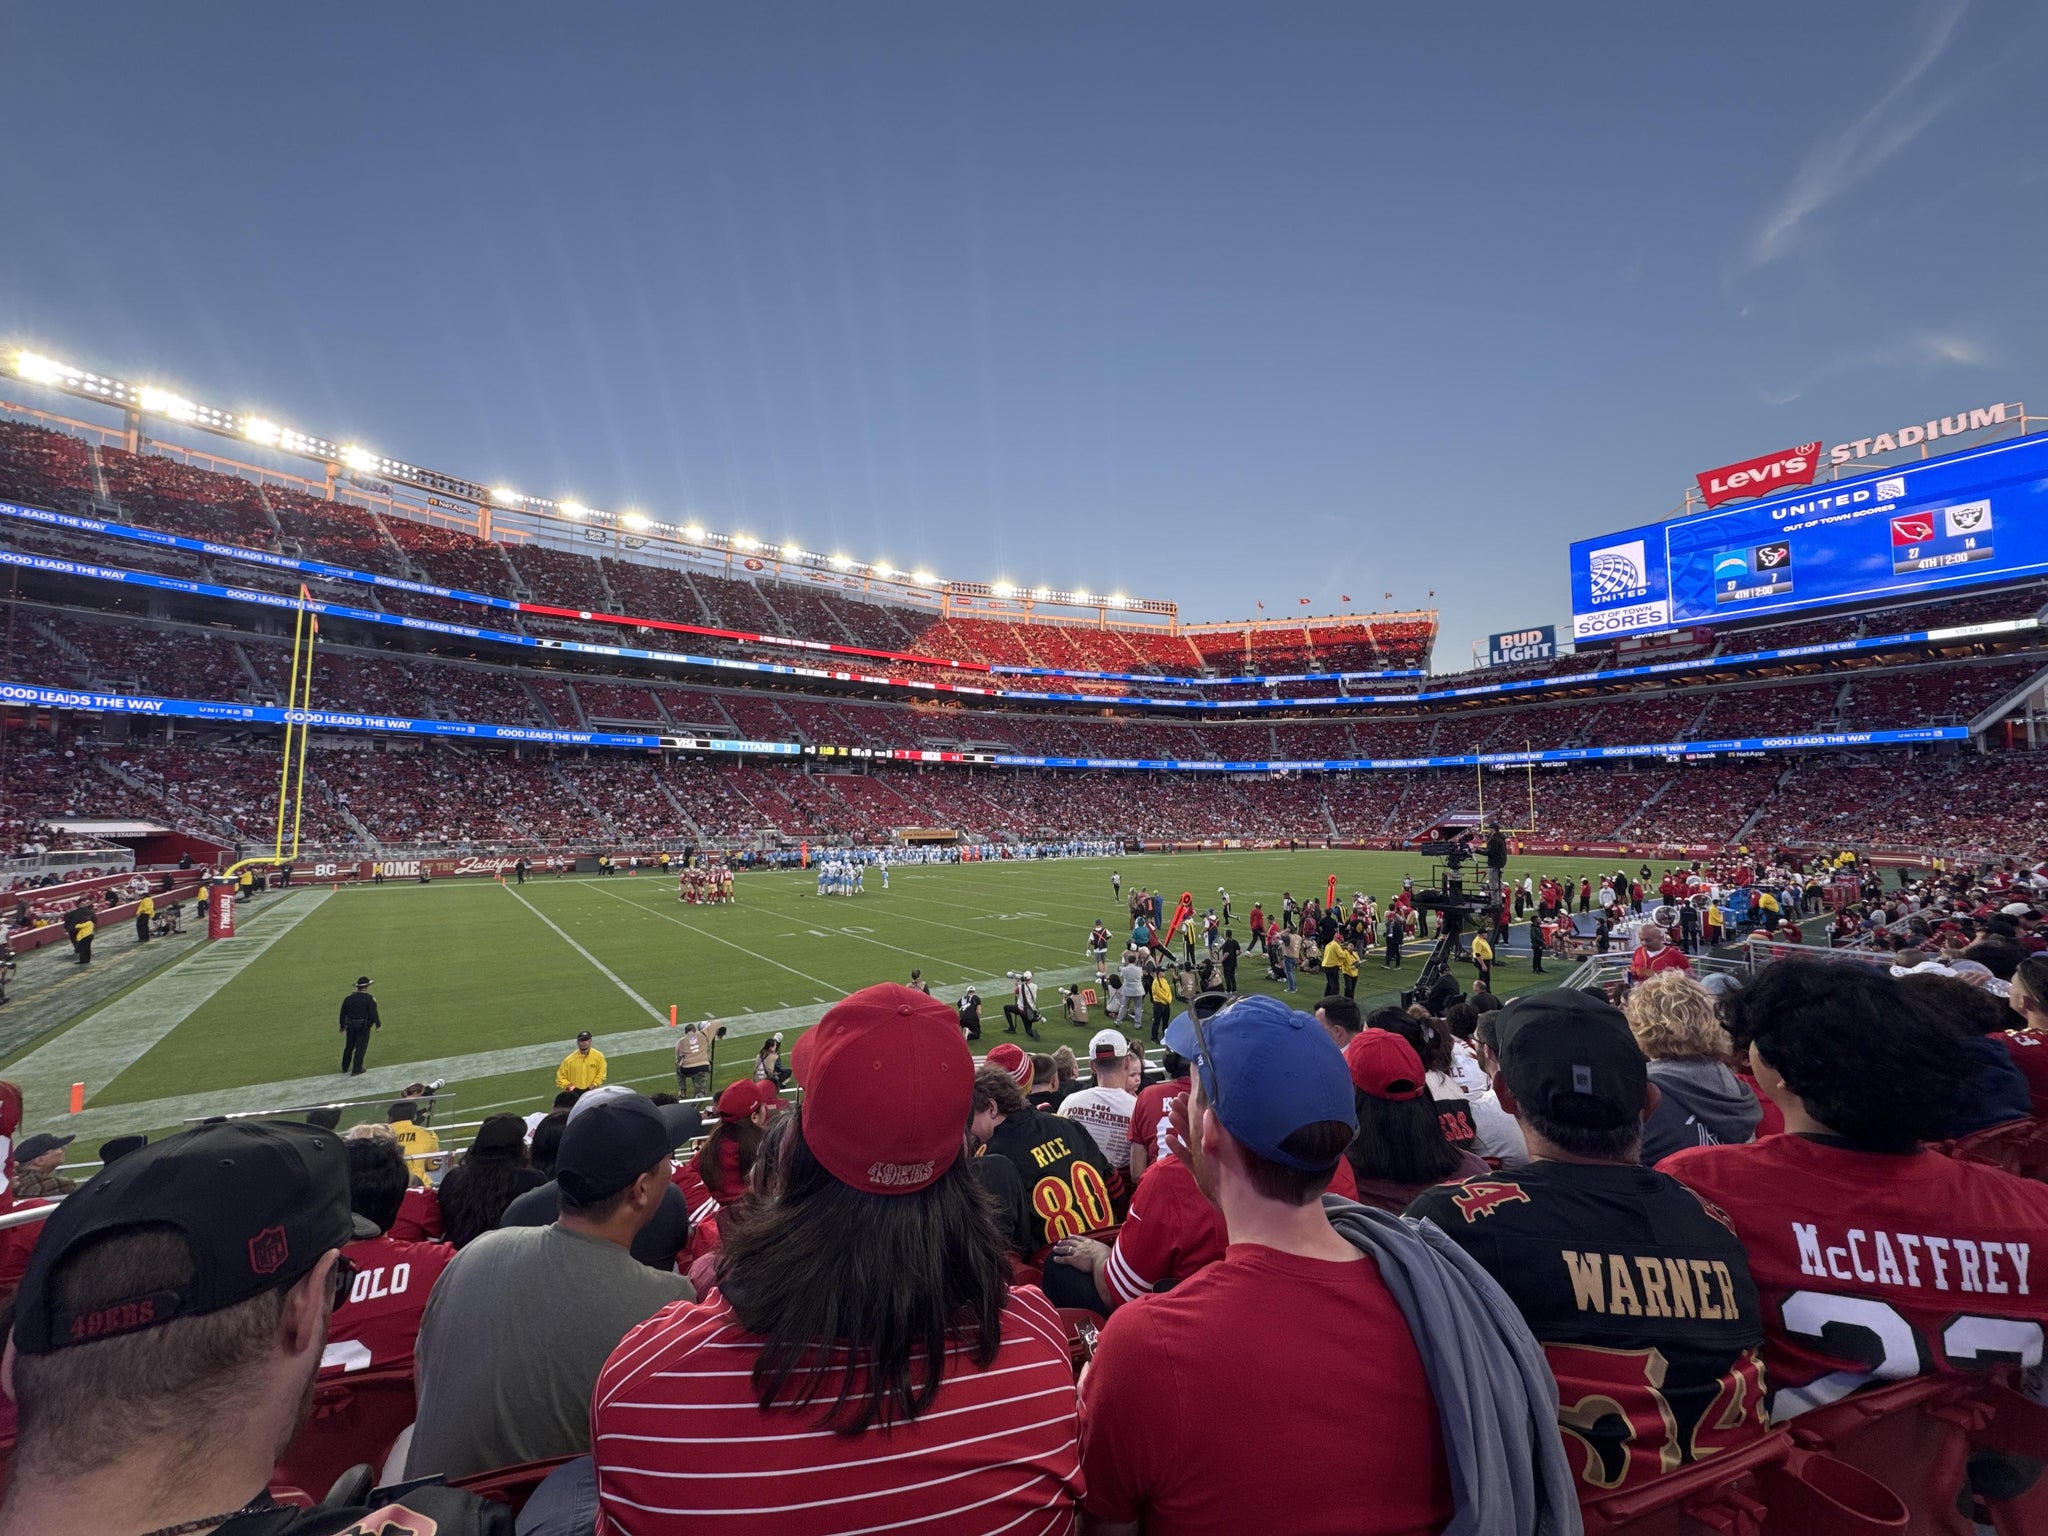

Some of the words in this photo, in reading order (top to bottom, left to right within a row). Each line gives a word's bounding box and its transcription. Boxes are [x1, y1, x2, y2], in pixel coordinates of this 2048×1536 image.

[1830, 402, 2006, 464] STADIUM
[439, 501, 470, 514] NetApp
[1772, 490, 1870, 520] UNITED
[0, 504, 16, 514] OD
[58, 515, 80, 526] THE
[82, 520, 107, 532] WAY
[1783, 523, 1804, 532] OUT
[1805, 520, 1818, 528] OF
[1820, 513, 1851, 525] TOWN
[1852, 504, 1896, 518] SCORES
[585, 534, 606, 543] LIGHT
[626, 538, 644, 547] SAP
[1964, 537, 1976, 549] 14
[204, 544, 232, 556] GOOD
[234, 549, 262, 562] LEADS
[264, 555, 280, 565] THE
[281, 558, 300, 568] WAY
[1908, 548, 1920, 560] 27
[1918, 558, 1937, 570] 4TH
[1945, 552, 1968, 565] 2:00
[34, 557, 74, 572] LEADS
[76, 564, 98, 576] THE
[100, 568, 126, 581] WAY
[1771, 572, 1778, 583] 7
[374, 576, 398, 588] GOOD
[398, 580, 422, 592] LEADS
[422, 585, 435, 594] THE
[436, 588, 452, 598] WAY
[1727, 580, 1736, 590] 27
[1734, 590, 1750, 600] 4TH
[1755, 585, 1773, 596] 2:00
[226, 588, 257, 601] GOOD
[258, 594, 288, 607] LEADS
[306, 602, 327, 612] WAY
[1592, 588, 1648, 604] UNITED
[1578, 611, 1662, 634] SCORES
[1587, 612, 1606, 622] OUT
[1608, 610, 1621, 618] OF
[1622, 605, 1652, 616] TOWN
[402, 618, 426, 628] GOOD
[426, 622, 450, 632] LEADS
[450, 626, 464, 635] THE
[464, 628, 480, 638] WAY
[1500, 630, 1543, 650] BUD
[1777, 648, 1800, 657] GOOD
[1800, 645, 1824, 654] LEADS
[1824, 644, 1838, 652] THE
[1839, 640, 1856, 650] WAY
[1492, 643, 1552, 664] LIGHT
[1650, 664, 1668, 672] GOOD
[0, 686, 38, 701] OOD
[40, 690, 91, 706] LEADS
[94, 696, 126, 708] THE
[127, 698, 164, 712] WAY
[199, 706, 241, 716] UNITED
[284, 710, 324, 724] GOOD
[325, 714, 363, 726] LEADS
[364, 718, 386, 728] THE
[387, 720, 413, 730] WAY
[436, 725, 467, 733] UNITED
[496, 728, 525, 738] GOOD
[526, 730, 554, 740] LEADS
[554, 732, 571, 742] THE
[572, 734, 592, 743] WAY
[1762, 738, 1792, 747] GOOD
[1793, 736, 1825, 746] LEADS
[1826, 736, 1846, 744] THE
[1847, 734, 1872, 742] WAY
[436, 862, 455, 872] THE
[454, 856, 520, 874] Faithful
[220, 894, 234, 930] FOOTBALL
[1084, 990, 1096, 1004] 10
[1030, 1137, 1072, 1169] RICE
[868, 1160, 935, 1186] 49ERS
[1032, 1160, 1115, 1245] 80
[1792, 1222, 2030, 1295] McCAFFREY
[1560, 1250, 1740, 1321] WARNER
[70, 1300, 155, 1340] 49ERS
